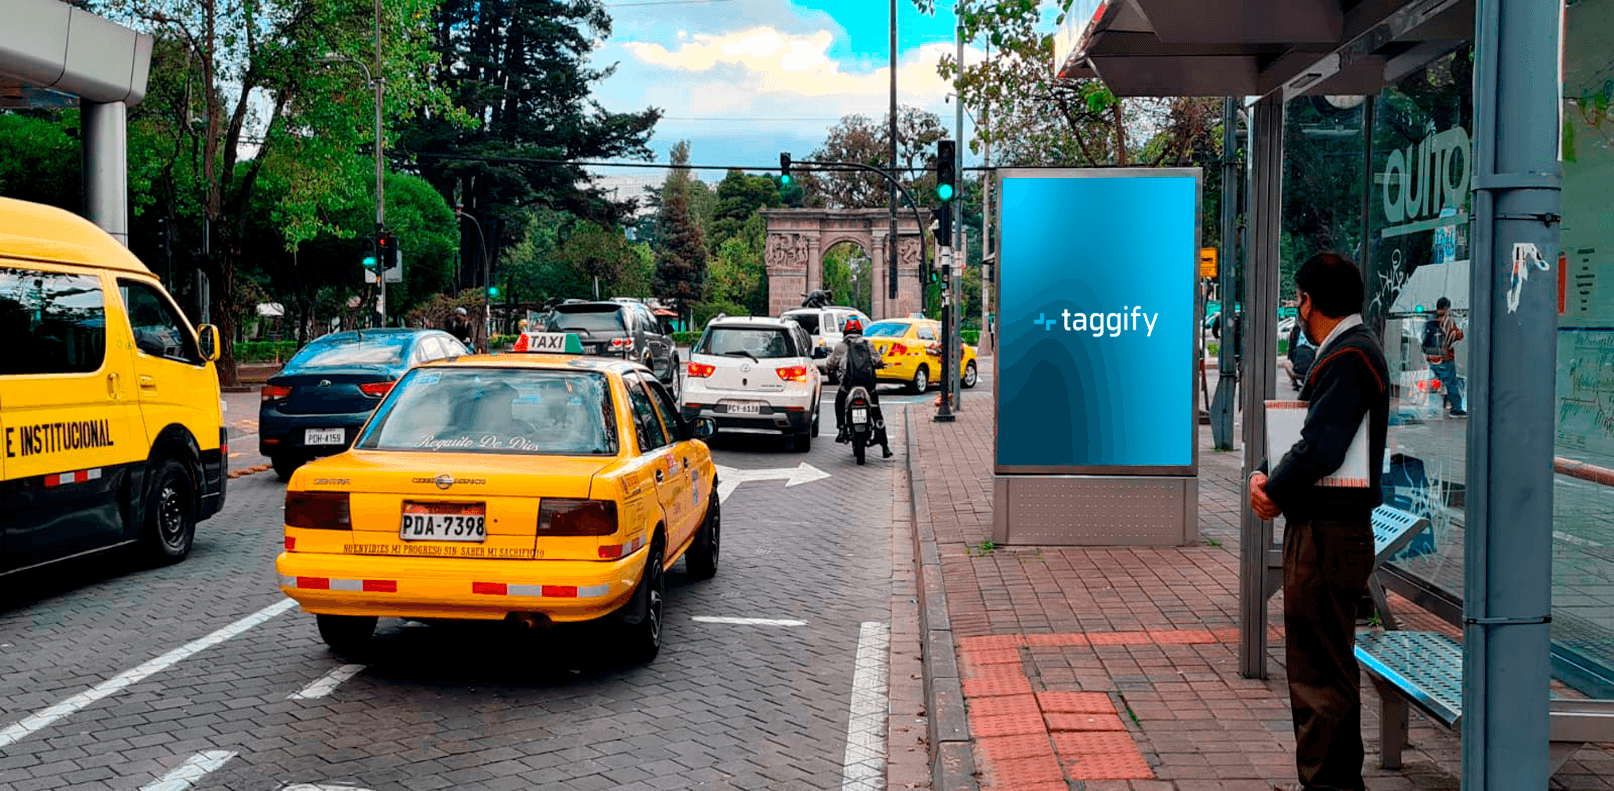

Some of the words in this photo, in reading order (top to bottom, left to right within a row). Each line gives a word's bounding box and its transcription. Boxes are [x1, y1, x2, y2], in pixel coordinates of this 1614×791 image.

[1383, 125, 1470, 223] QUITO
[1061, 305, 1158, 337] taggify
[531, 335, 563, 349] TAXI
[20, 419, 114, 457] INSTITUCIONAL
[480, 434, 502, 448] De
[509, 436, 539, 451] Dios
[403, 515, 485, 536] PDA-7398
[391, 545, 401, 554] MI
[403, 545, 442, 555] PROGRESO
[444, 546, 457, 556] SIN
[460, 546, 485, 557] SABER
[487, 548, 497, 556] MI
